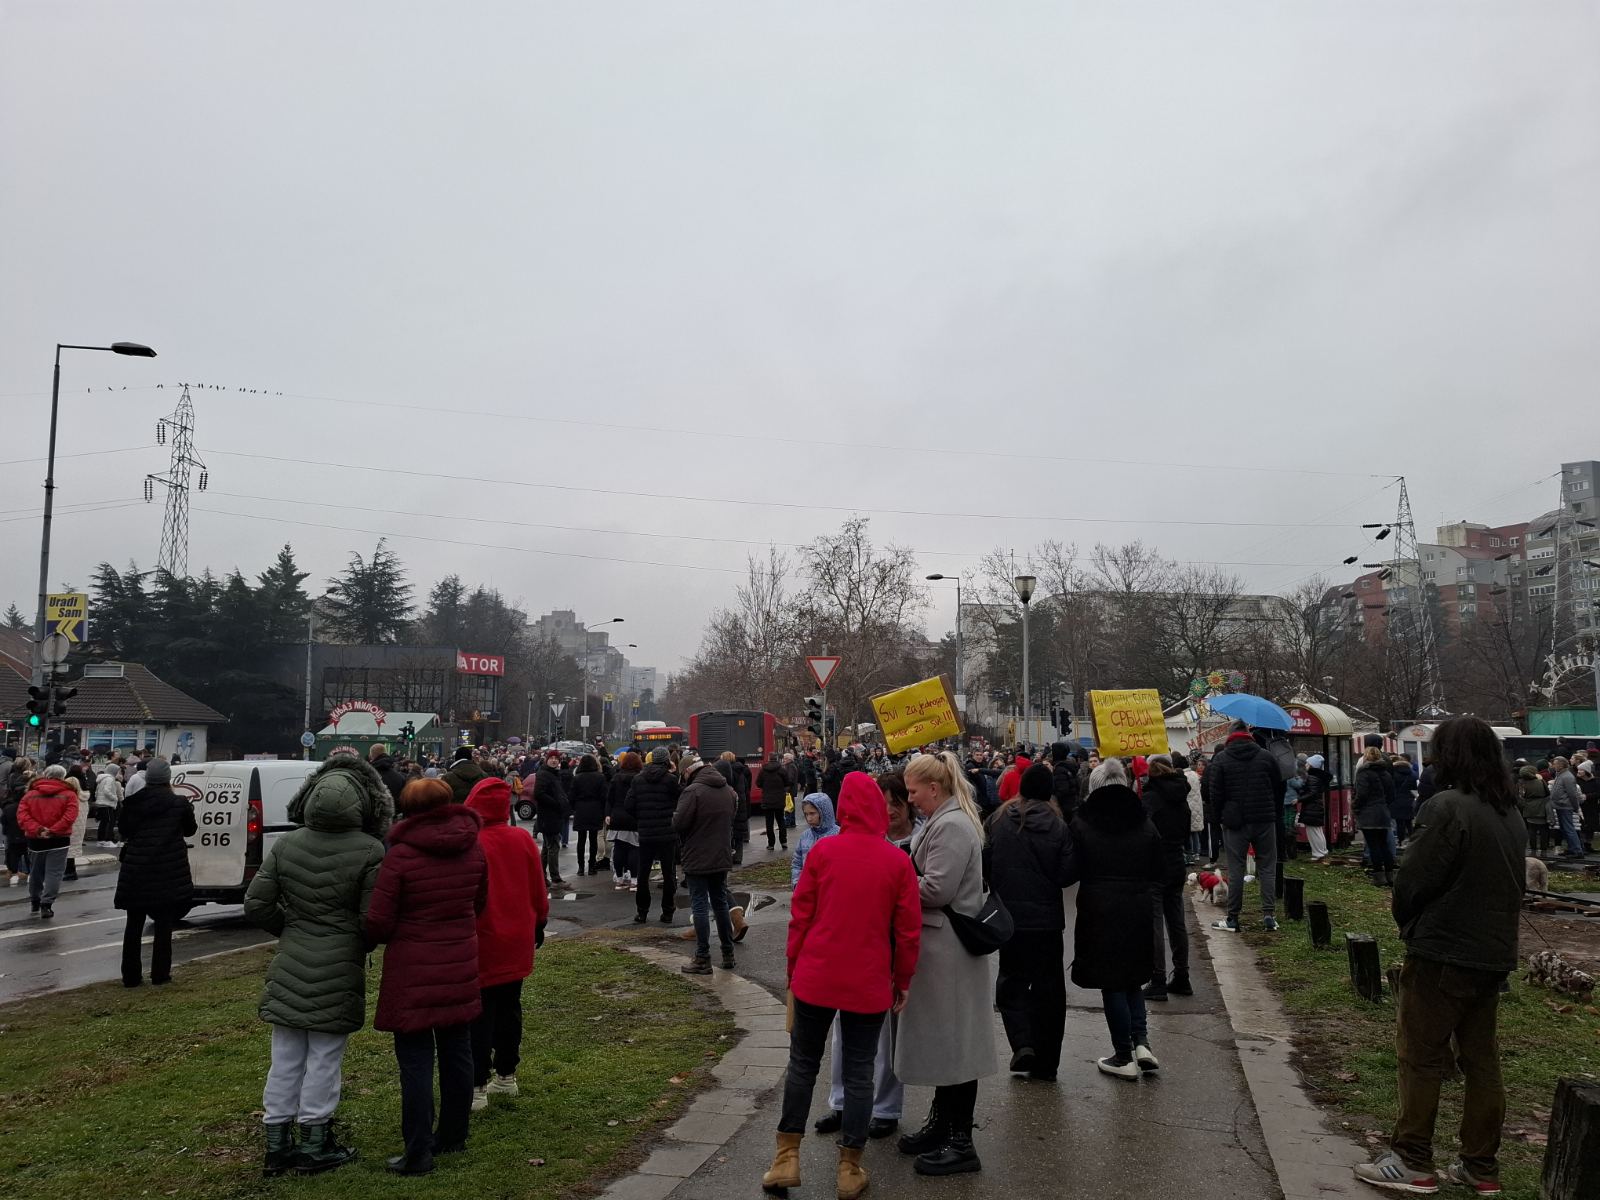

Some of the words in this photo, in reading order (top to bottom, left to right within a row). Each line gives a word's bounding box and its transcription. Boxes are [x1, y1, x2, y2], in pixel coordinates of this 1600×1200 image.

[49, 597, 78, 607] Uradi
[58, 608, 82, 618] Sam
[879, 702, 899, 723] Svi
[1111, 709, 1154, 727] СРБИЈА
[205, 791, 240, 804] 063
[202, 811, 232, 825] 661
[201, 832, 231, 846] 616
